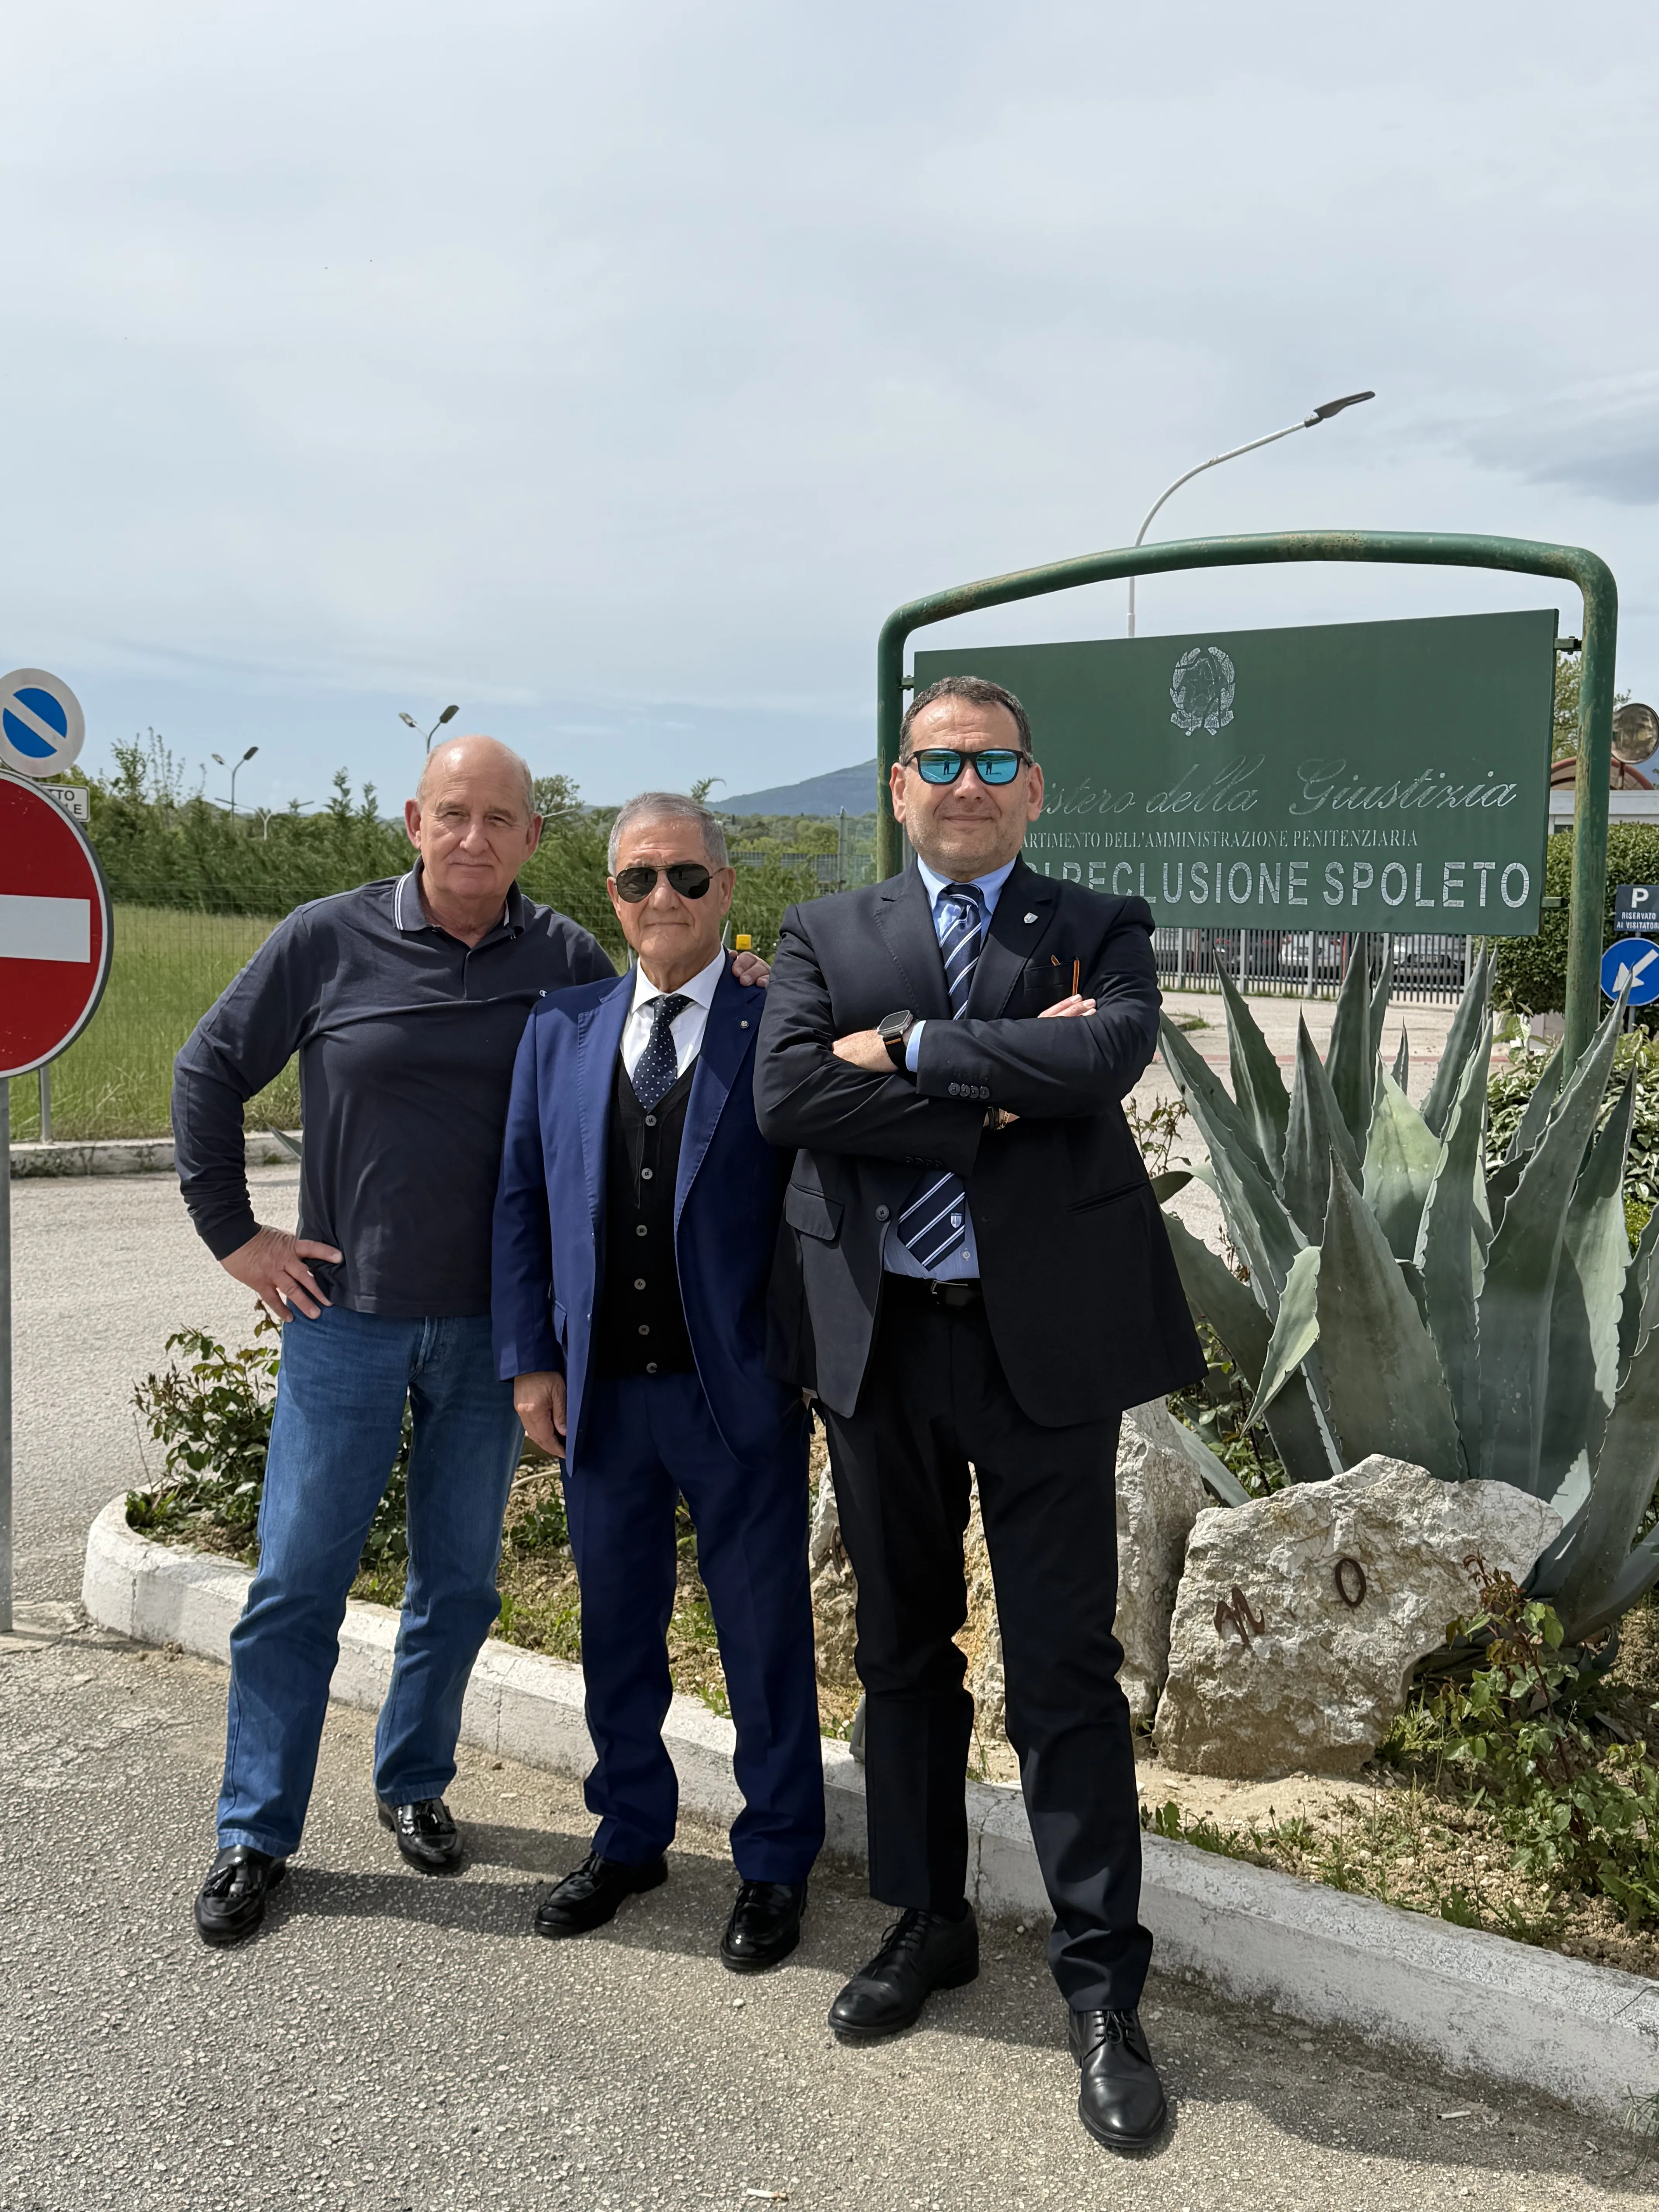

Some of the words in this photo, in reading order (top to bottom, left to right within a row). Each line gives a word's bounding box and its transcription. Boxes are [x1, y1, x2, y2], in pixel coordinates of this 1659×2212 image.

[1040, 778, 1135, 814] istero
[1146, 754, 1265, 812] della
[1289, 759, 1517, 815] Giustizia
[1021, 832, 1100, 848] ARTIMENTO
[1105, 830, 1288, 848] DELL'AMMINISTRAZIONE
[1293, 830, 1418, 847] PENITENZIARIA
[1323, 862, 1530, 908] SPOLETO
[1631, 888, 1649, 908] P
[1621, 912, 1656, 920] RISERVATO
